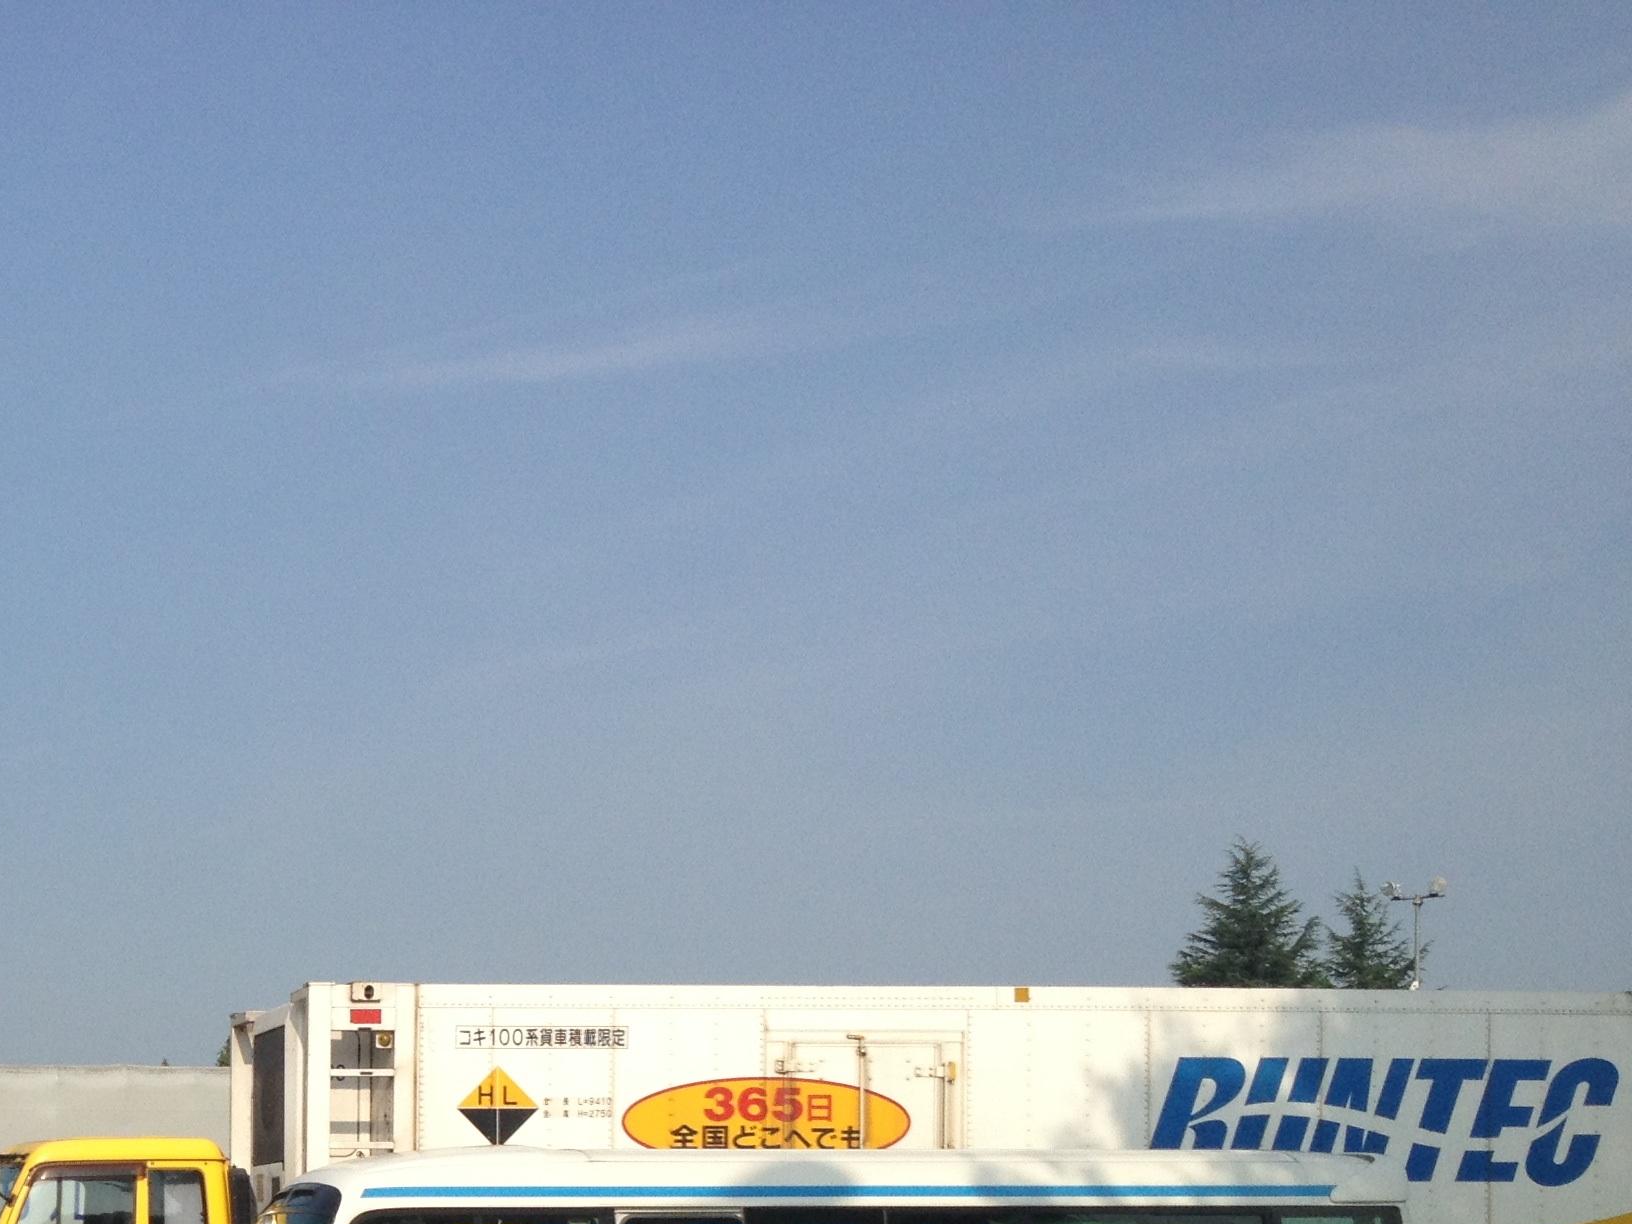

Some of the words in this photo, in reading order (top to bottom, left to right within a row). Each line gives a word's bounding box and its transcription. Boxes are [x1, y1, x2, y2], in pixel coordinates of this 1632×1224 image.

[459, 1028, 625, 1047] コキ100系貨車積載限定
[1148, 1057, 1620, 1187] RUNTEC
